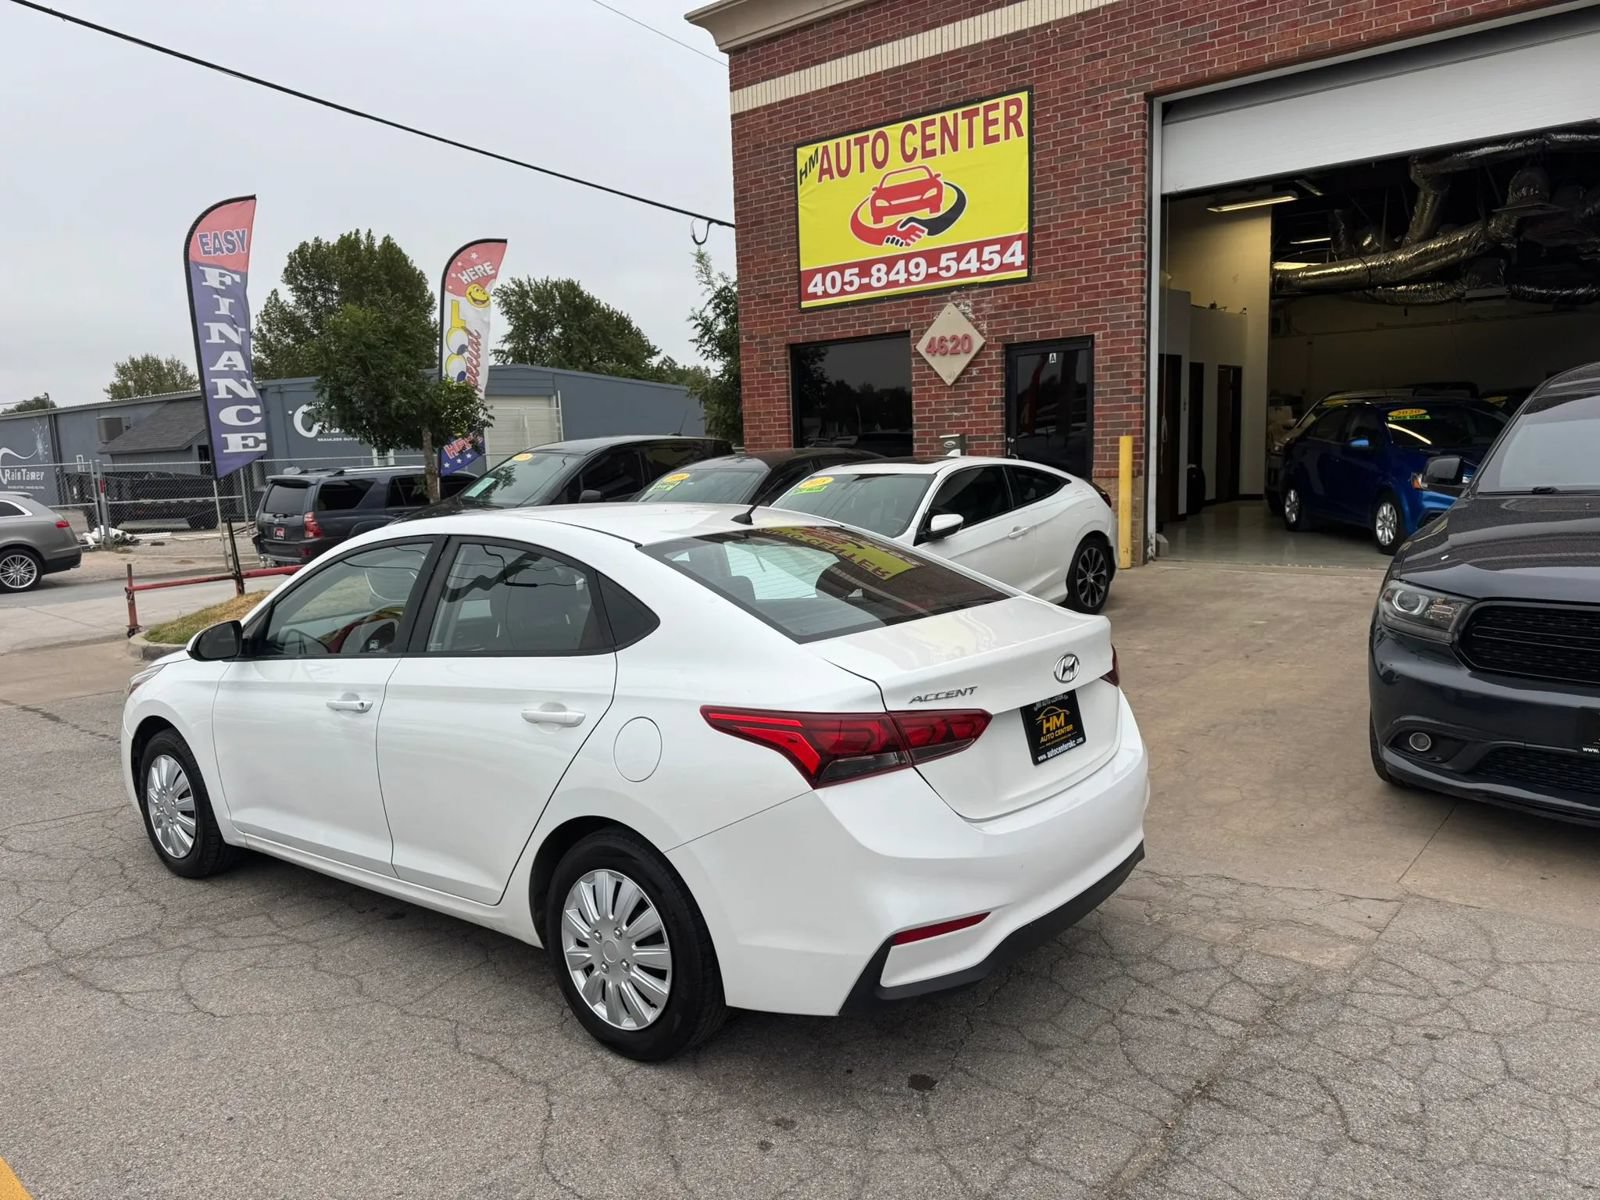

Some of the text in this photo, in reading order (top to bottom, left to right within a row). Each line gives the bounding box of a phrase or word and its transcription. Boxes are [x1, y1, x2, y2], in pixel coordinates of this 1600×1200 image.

[799, 96, 1025, 186] HM AUTO CENTER
[197, 229, 248, 256] EASY
[457, 261, 496, 285] HERE
[807, 240, 1025, 297] 405-849-5454
[925, 333, 973, 357] 4620
[198, 265, 268, 454] FINANCE
[462, 326, 482, 393] pecial
[909, 686, 979, 704] ACCENT
[1040, 732, 1055, 743] AUTO
[1054, 724, 1073, 737] CENTER
[1042, 712, 1065, 734] HM
